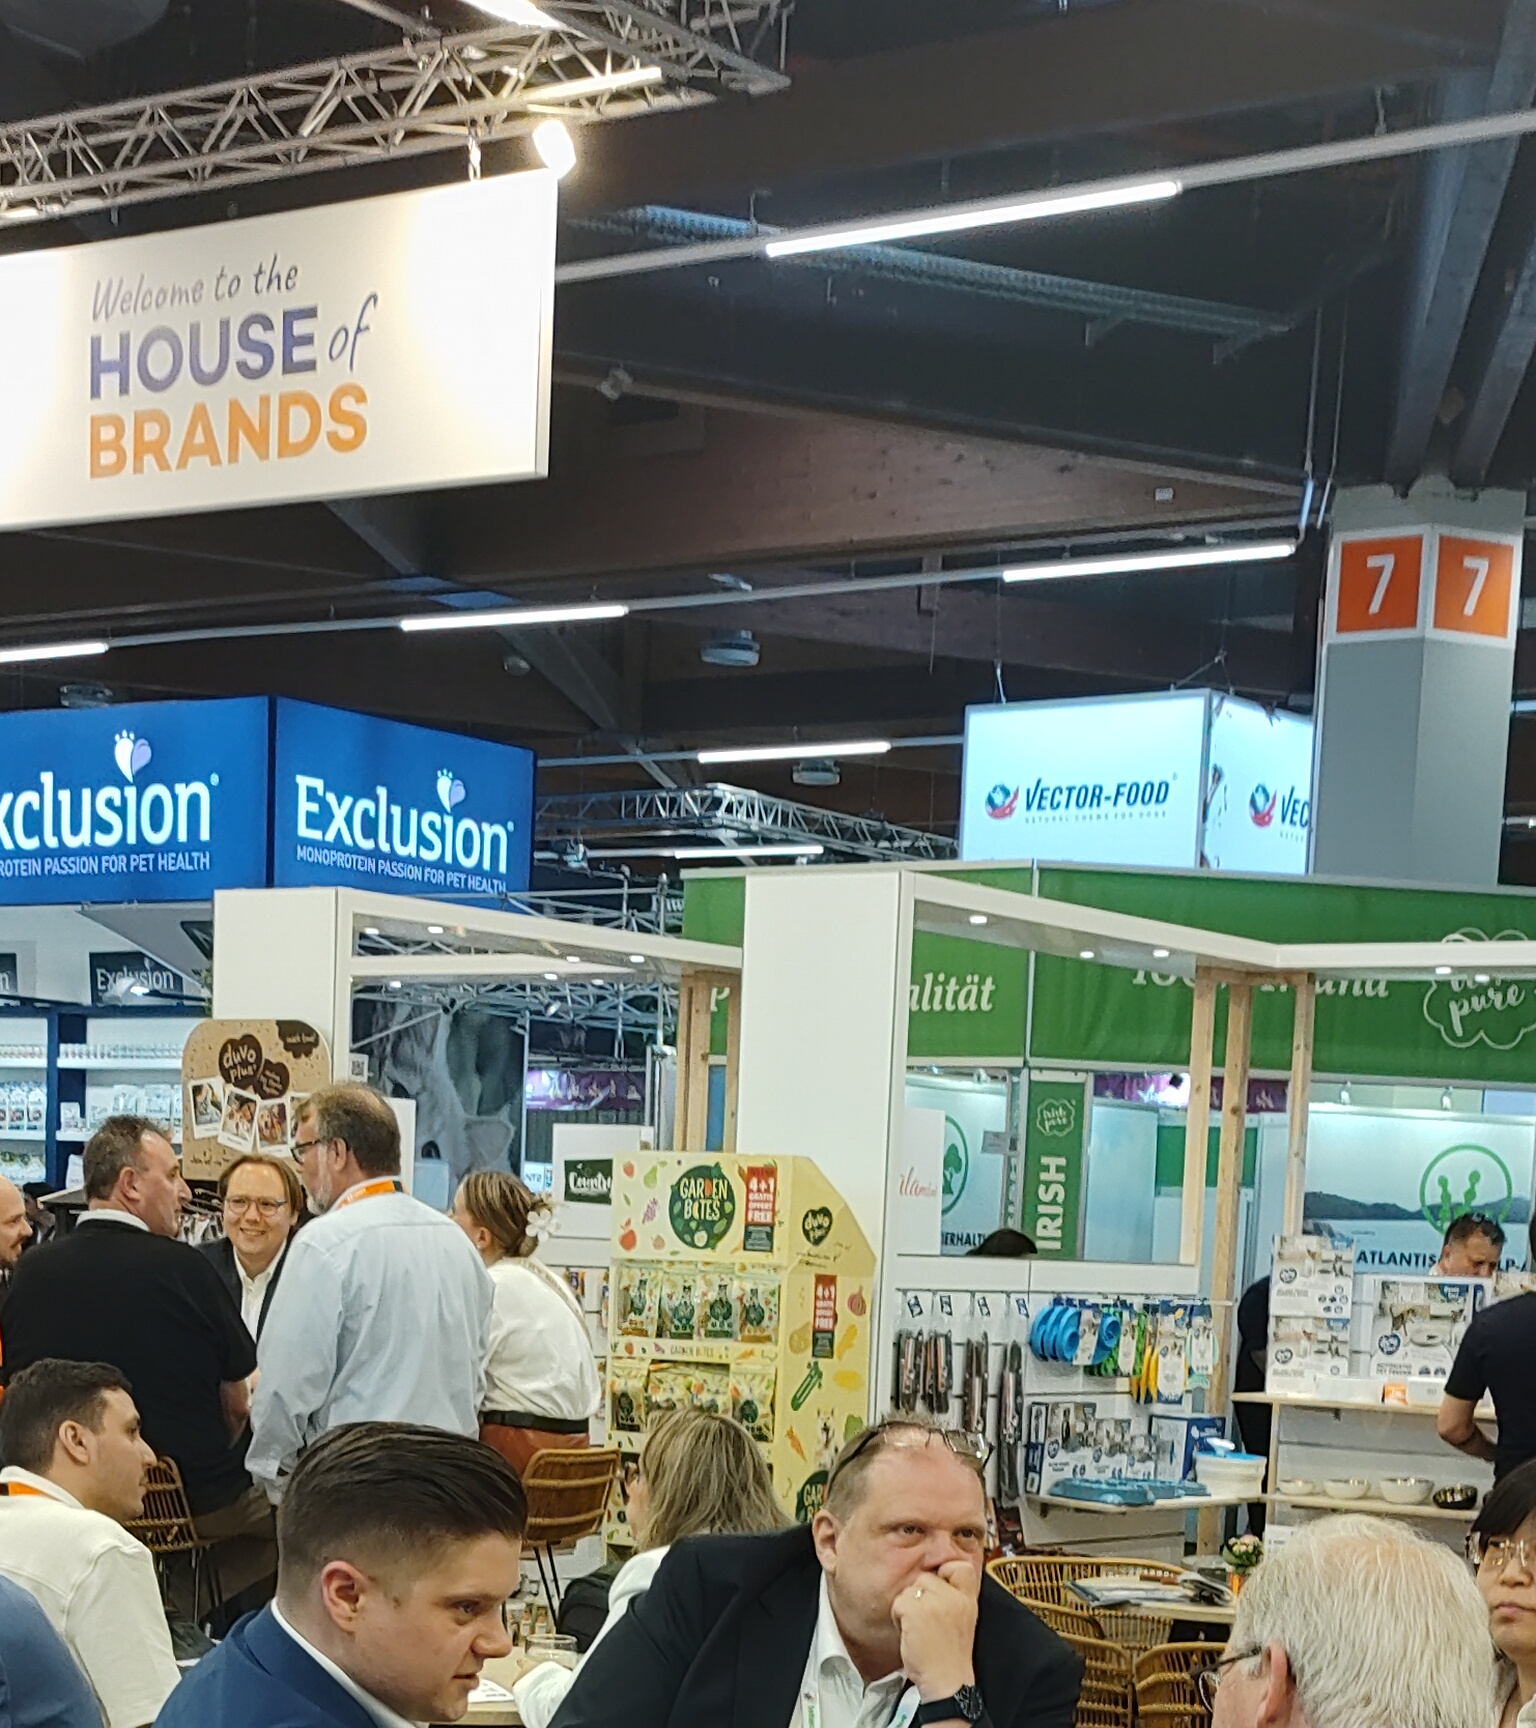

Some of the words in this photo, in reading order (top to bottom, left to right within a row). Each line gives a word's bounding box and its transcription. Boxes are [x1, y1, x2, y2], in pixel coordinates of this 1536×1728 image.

[91, 273, 205, 322] Welcome
[214, 265, 241, 301] to
[253, 252, 299, 296] the
[89, 305, 318, 401] HOUSE
[327, 291, 378, 373] of
[89, 381, 369, 480] BRANDS
[1366, 553, 1395, 616] 7
[1463, 556, 1490, 617] 7
[1025, 777, 1170, 813] VECTOR-FOOD
[296, 774, 508, 875] Exclusion
[44, 855, 99, 876] PASSION
[101, 854, 127, 873] FOR
[130, 852, 154, 872] PET
[161, 851, 210, 872] HEALTH
[296, 844, 376, 874] MONOPROTEIN
[378, 858, 423, 882] PASSION
[424, 866, 445, 885] FOR
[446, 871, 466, 888] PET
[467, 874, 507, 894] HEALTH
[1448, 985, 1525, 1038] pure
[223, 1043, 257, 1069] duvo
[679, 1177, 728, 1200] GARDEN
[749, 1177, 775, 1193] 4+1
[1036, 1155, 1067, 1250] IRISH
[747, 1210, 773, 1223] FREE
